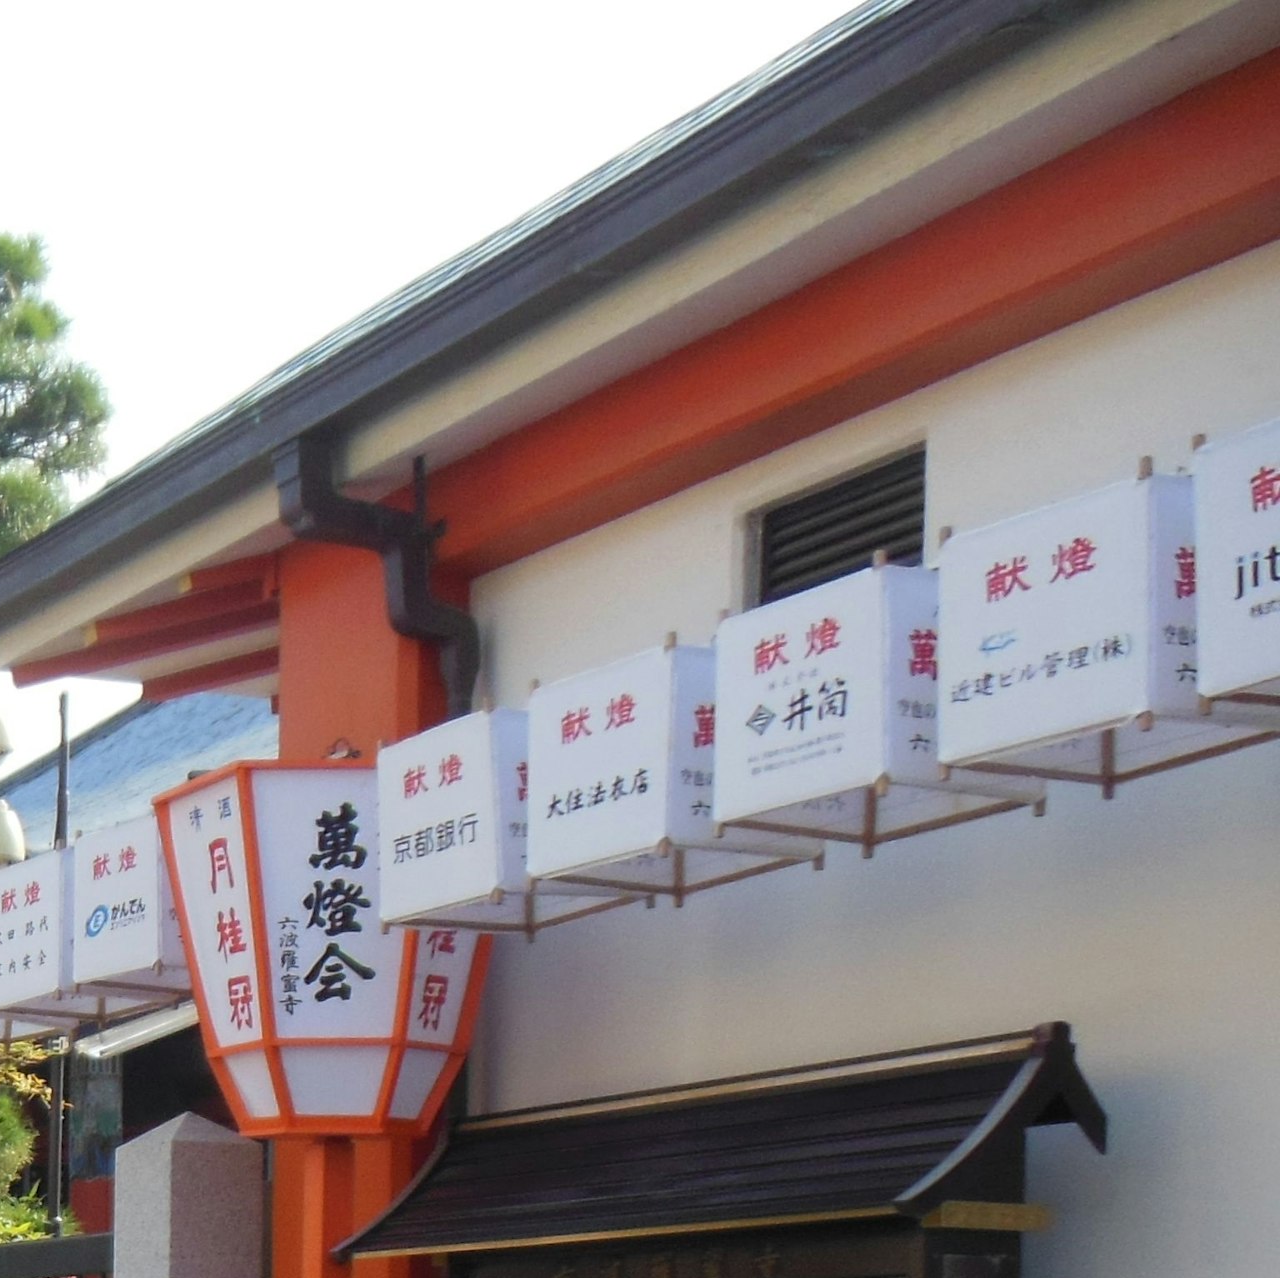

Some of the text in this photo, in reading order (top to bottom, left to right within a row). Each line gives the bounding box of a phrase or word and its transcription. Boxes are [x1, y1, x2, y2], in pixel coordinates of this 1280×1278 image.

[985, 537, 1097, 603] 献燈
[754, 617, 841, 676] 献燈
[561, 693, 637, 744] 献燈
[782, 678, 848, 731] 井筒
[403, 754, 463, 799] 献燈
[92, 847, 137, 880] 献燈
[393, 812, 479, 864] 京都銀行
[0, 882, 41, 914] 献燈
[303, 801, 376, 1002] 萬燈会
[208, 837, 253, 1031] 月桂冠
